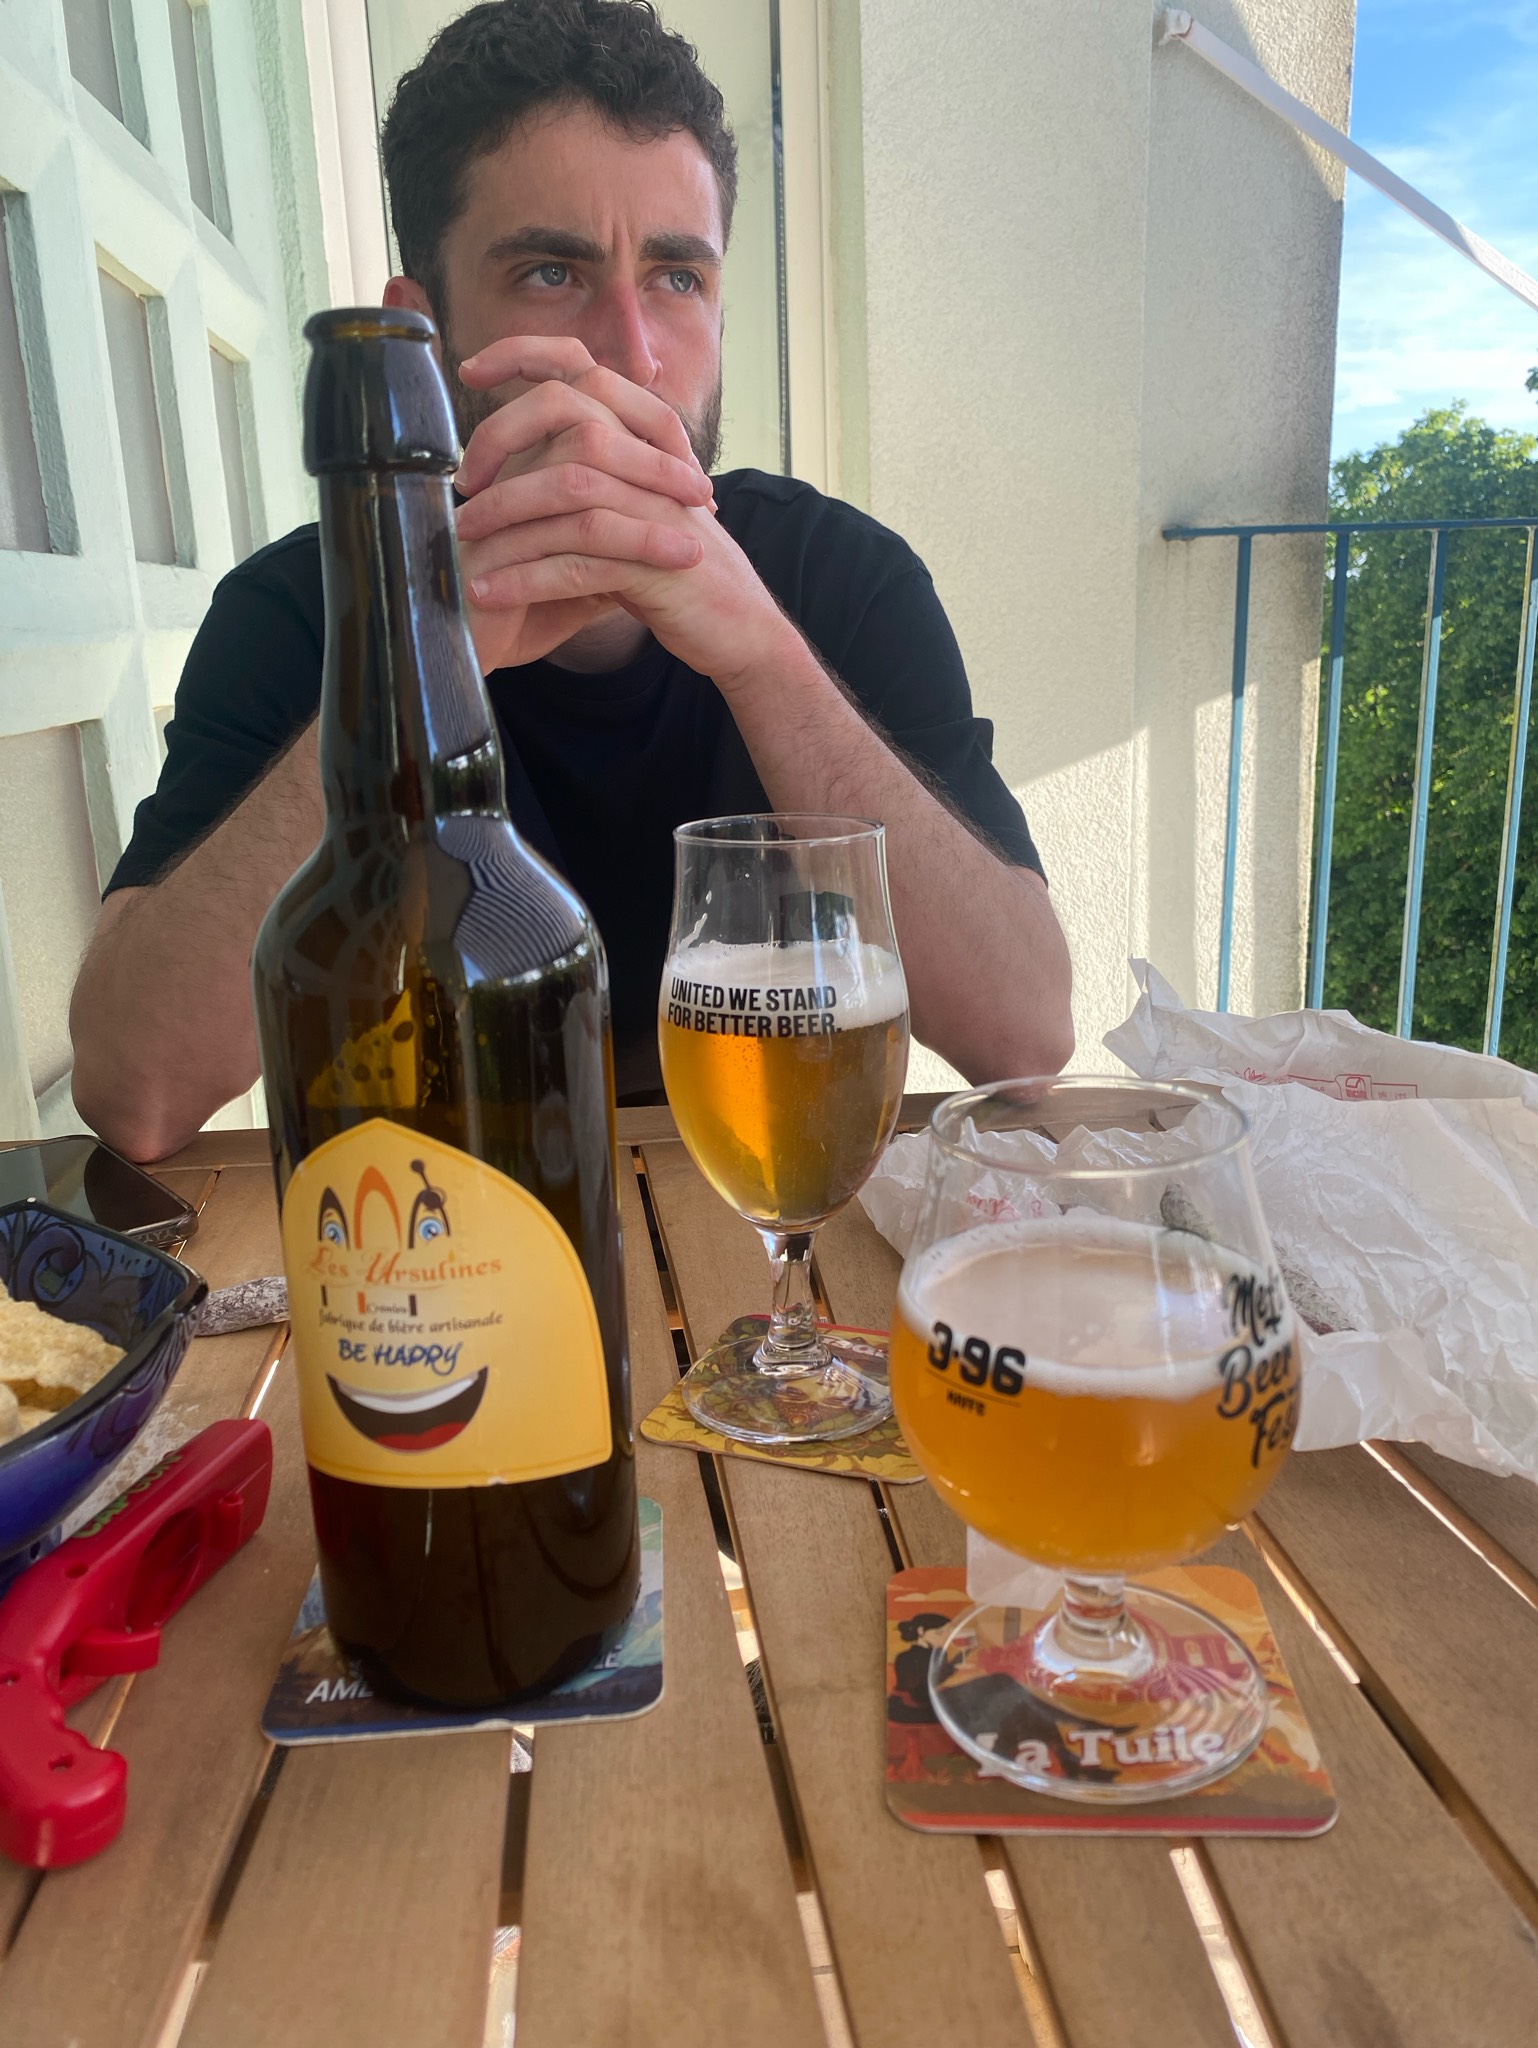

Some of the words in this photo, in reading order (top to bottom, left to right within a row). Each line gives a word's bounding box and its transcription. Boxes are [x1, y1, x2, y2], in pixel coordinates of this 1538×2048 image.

[671, 977, 725, 1010] UNITED
[728, 987, 762, 1012] WE
[765, 986, 838, 1013] STAND
[667, 1002, 692, 1030] FOR
[694, 1009, 772, 1038] BETTER
[777, 1012, 843, 1039] BEER.
[307, 1246, 349, 1278] Les
[362, 1249, 503, 1285] Ursulines
[368, 1319, 385, 1333] de
[388, 1319, 425, 1335] bière
[429, 1311, 504, 1333] artisanale
[338, 1337, 368, 1363] BE
[373, 1340, 464, 1377] HAPPY
[1216, 1343, 1293, 1420] Beer
[1066, 1725, 1226, 1769] Tuile
